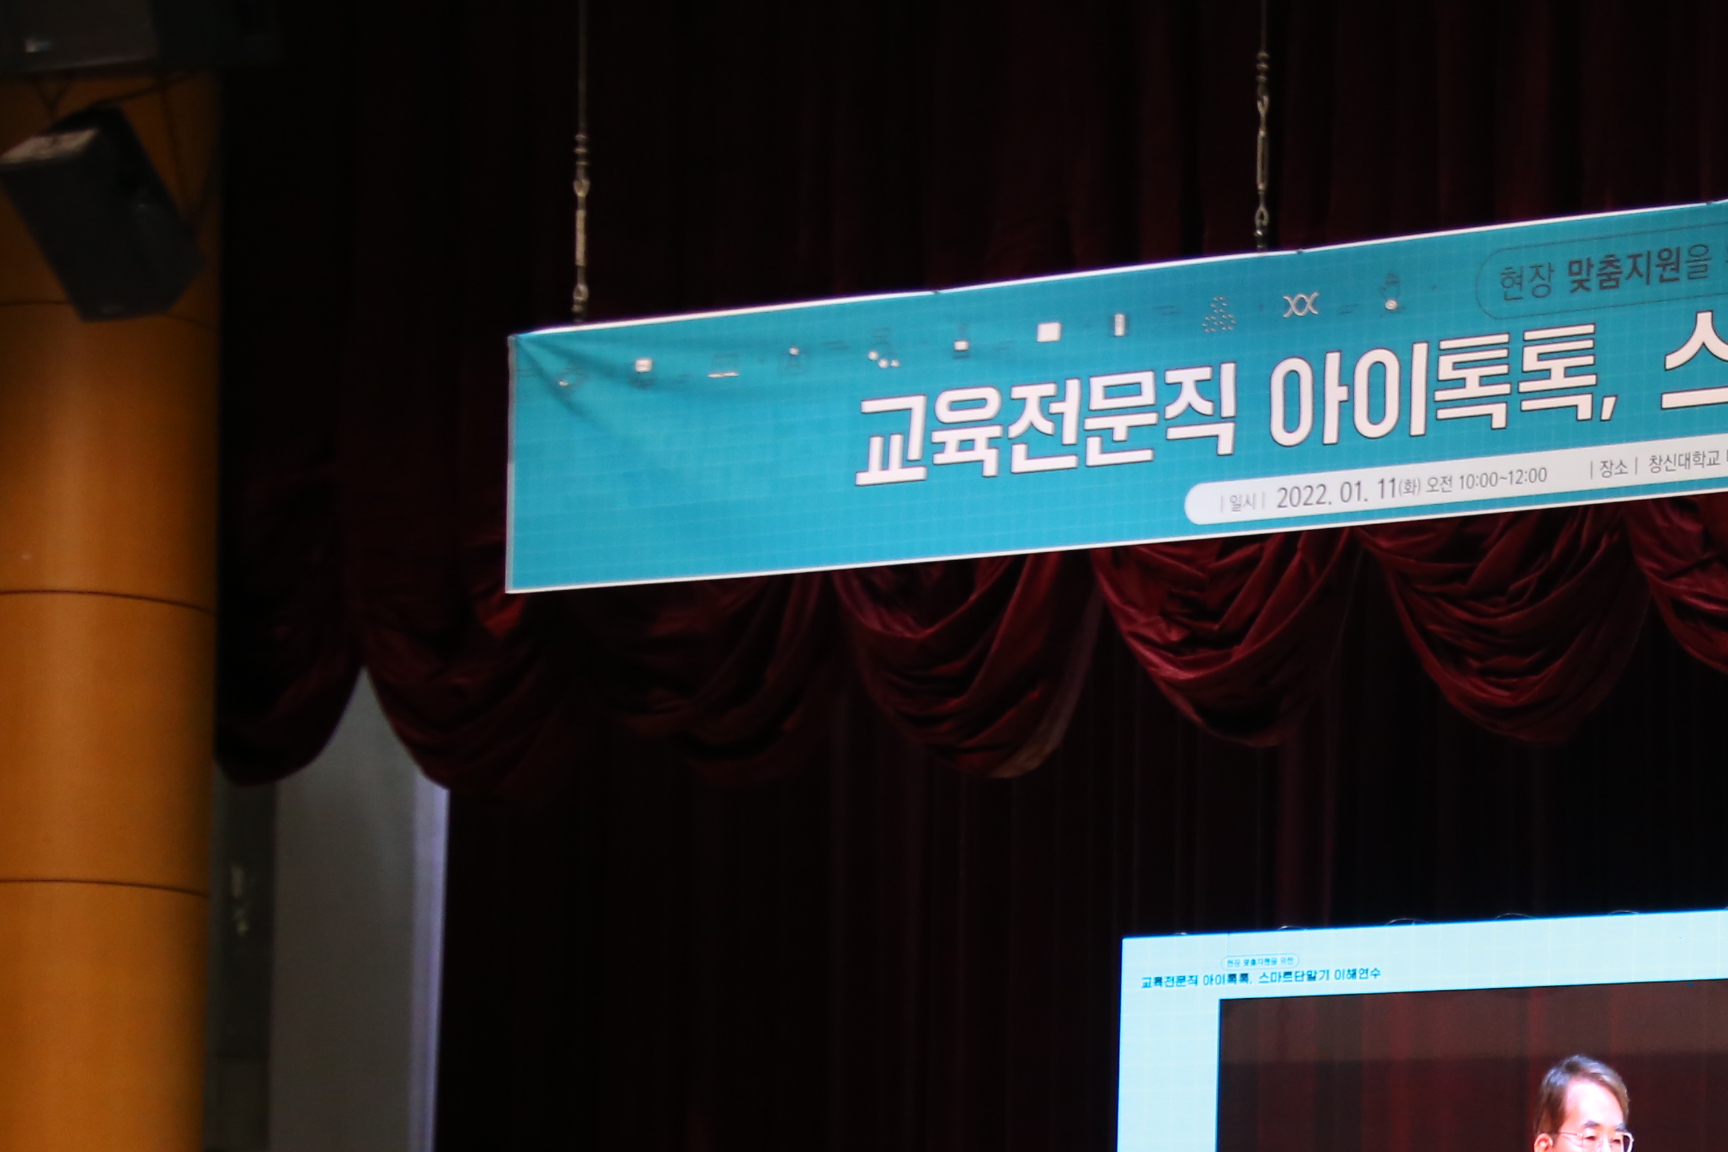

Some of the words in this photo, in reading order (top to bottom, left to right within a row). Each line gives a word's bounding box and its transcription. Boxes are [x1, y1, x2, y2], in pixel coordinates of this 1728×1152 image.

[1500, 261, 1556, 301] 현장
[1568, 243, 1713, 294] 맞춤지원을
[855, 361, 1237, 486] 교육전문직
[1268, 321, 1618, 447] 아이톡톡,
[1600, 459, 1629, 478] 장소
[1648, 449, 1721, 474] 창신대학교
[1276, 485, 1332, 510] 2022.
[1340, 482, 1368, 503] 01.
[1426, 474, 1453, 493] 오전
[1459, 466, 1548, 490] 10:00~12:00
[1141, 974, 1199, 989] 교육전문직
[1258, 969, 1331, 985] 스마트단말기
[1334, 967, 1382, 982] 이해연수
